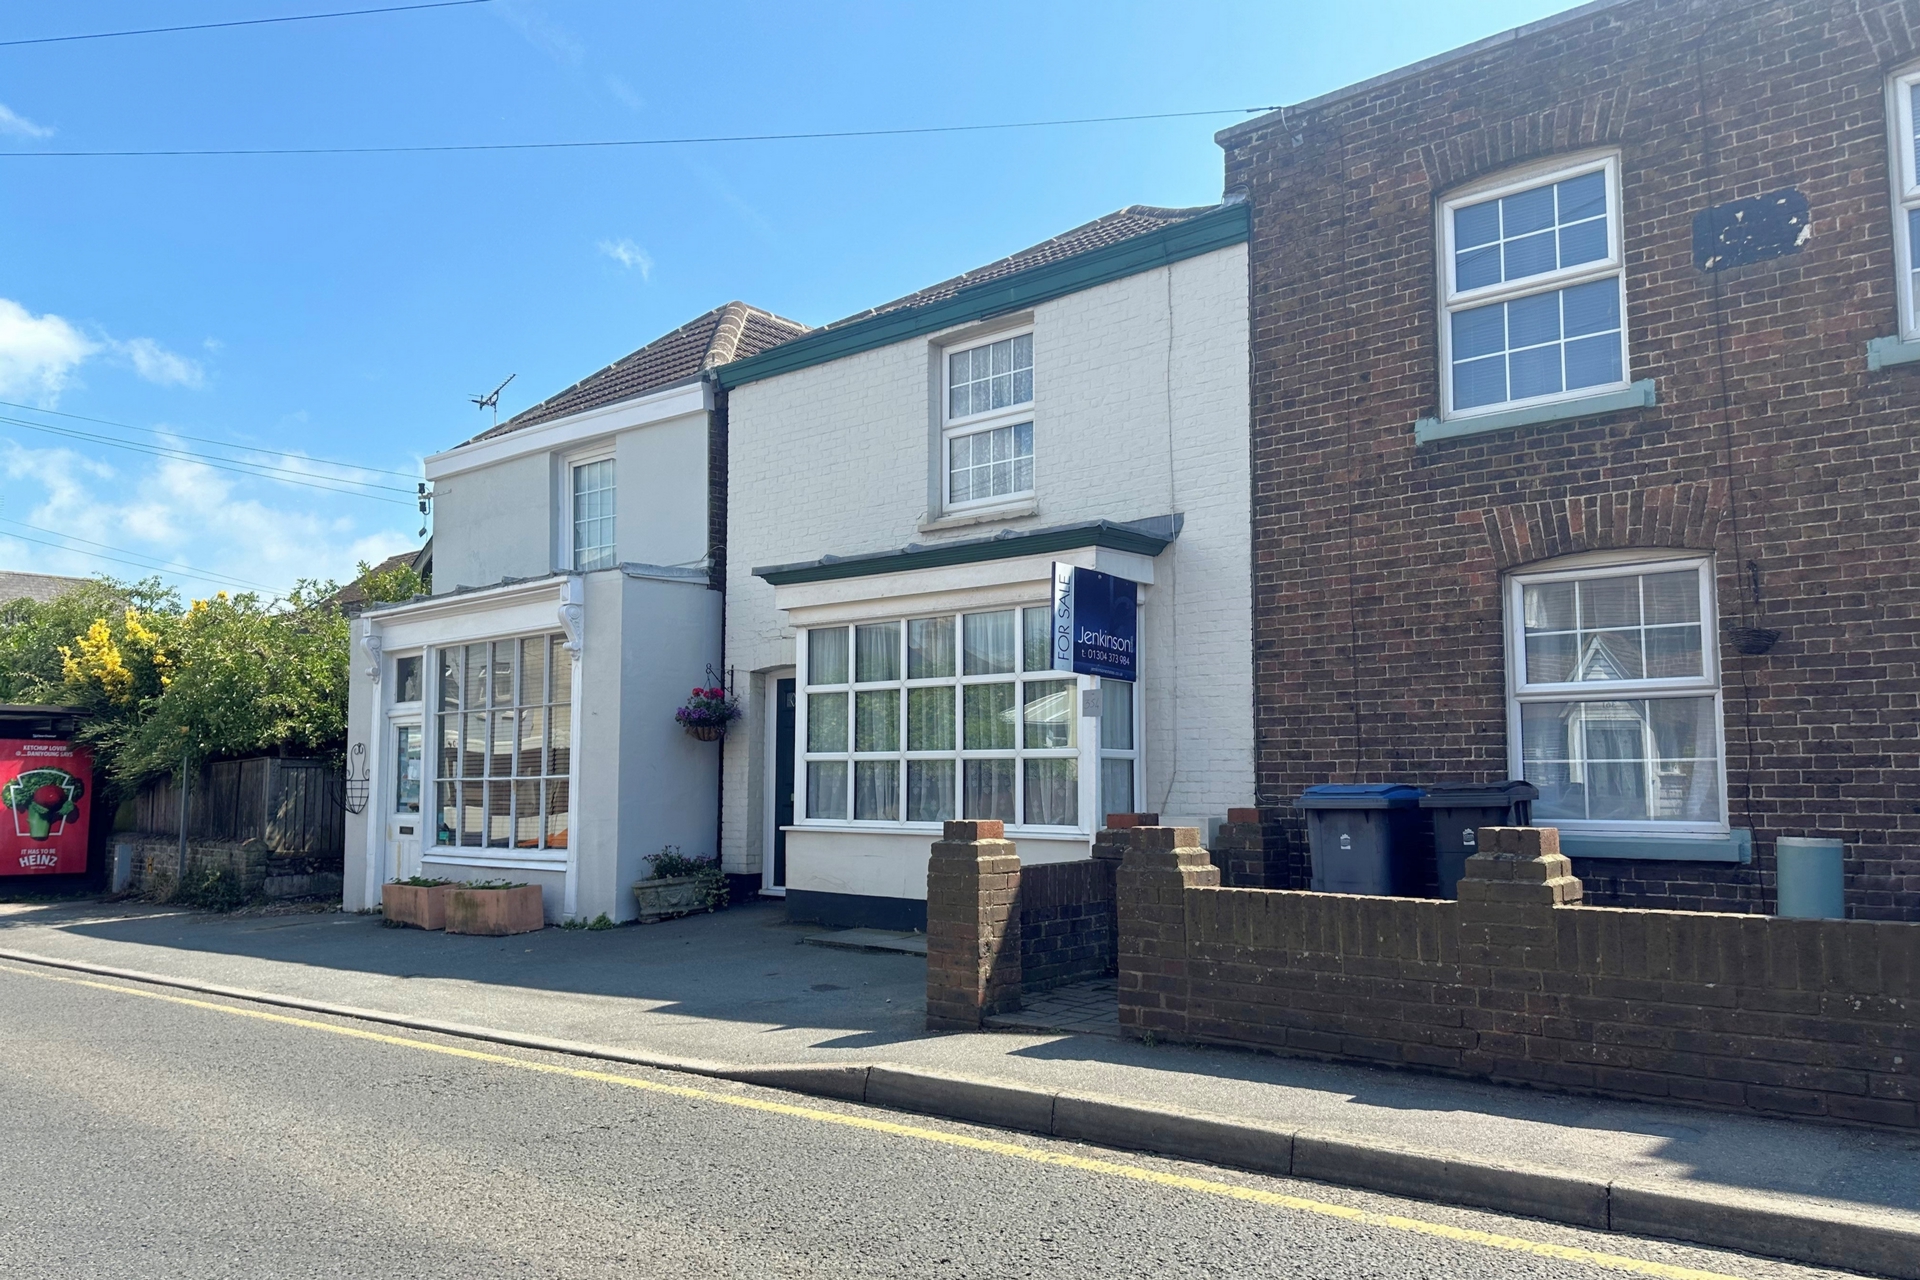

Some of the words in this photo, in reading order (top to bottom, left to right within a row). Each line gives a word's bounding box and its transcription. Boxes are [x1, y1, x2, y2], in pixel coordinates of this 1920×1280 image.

[1059, 574, 1071, 619] SALE
[1058, 625, 1070, 660] FOR
[1078, 626, 1130, 652] Jenkinson
[1088, 648, 1107, 661] 01304
[1108, 652, 1119, 664] 373
[1119, 655, 1130, 666] 984
[19, 854, 58, 867] HEINZ
